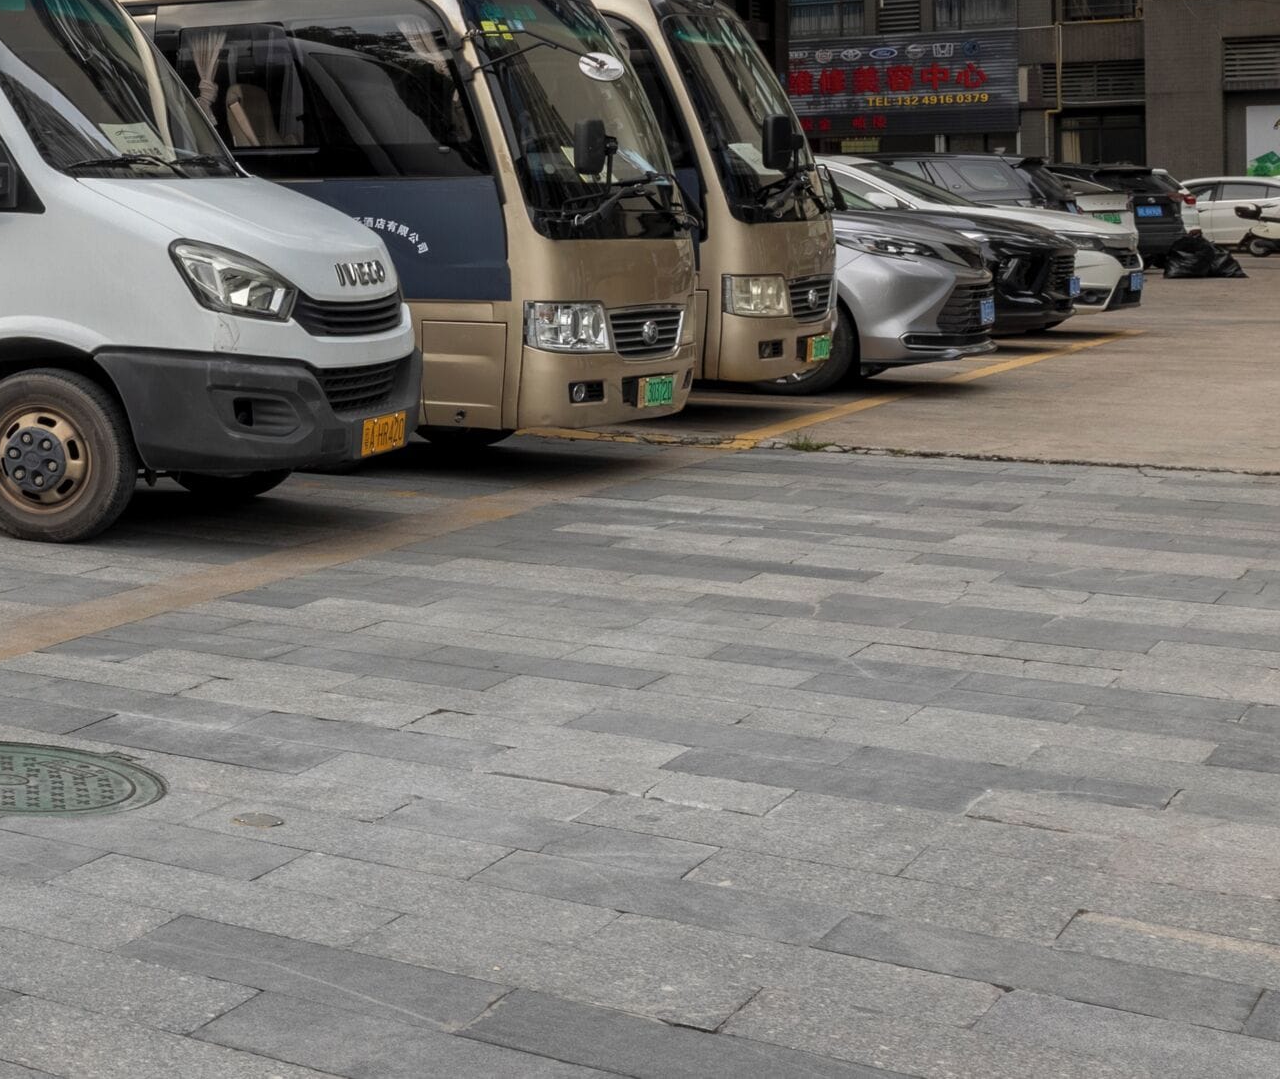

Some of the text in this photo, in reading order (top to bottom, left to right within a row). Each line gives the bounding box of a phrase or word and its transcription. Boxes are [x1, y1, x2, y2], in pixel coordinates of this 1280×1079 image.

[922, 94, 953, 105] 4916
[956, 92, 989, 103] 0379
[335, 260, 386, 287] IVECO
